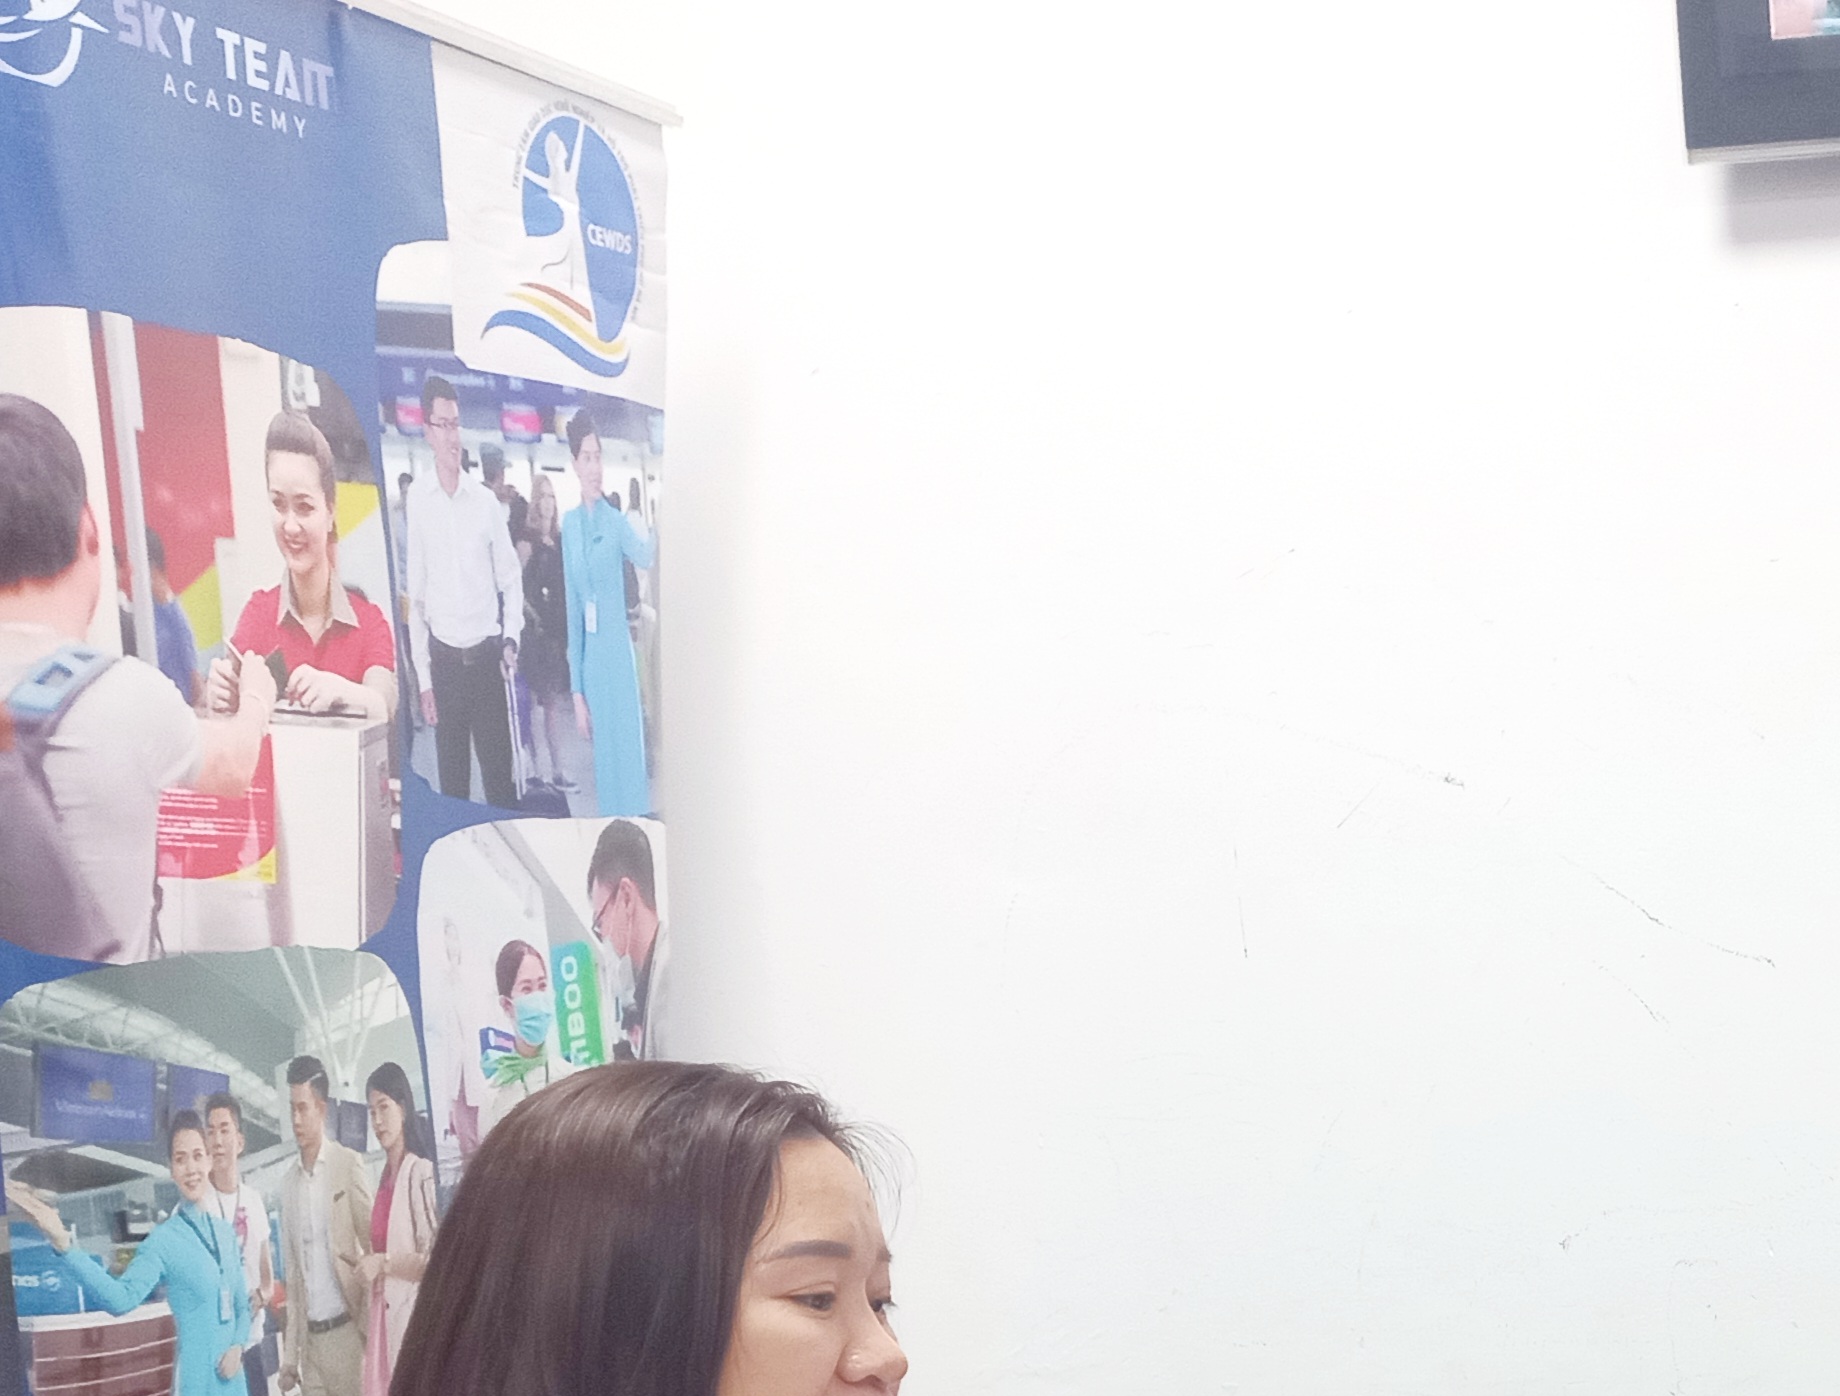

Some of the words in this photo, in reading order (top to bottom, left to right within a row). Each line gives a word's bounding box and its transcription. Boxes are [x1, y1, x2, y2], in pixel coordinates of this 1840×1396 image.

[113, 0, 196, 66] SKY
[163, 73, 306, 138] ACADEMY
[587, 223, 632, 255] CEWDS
